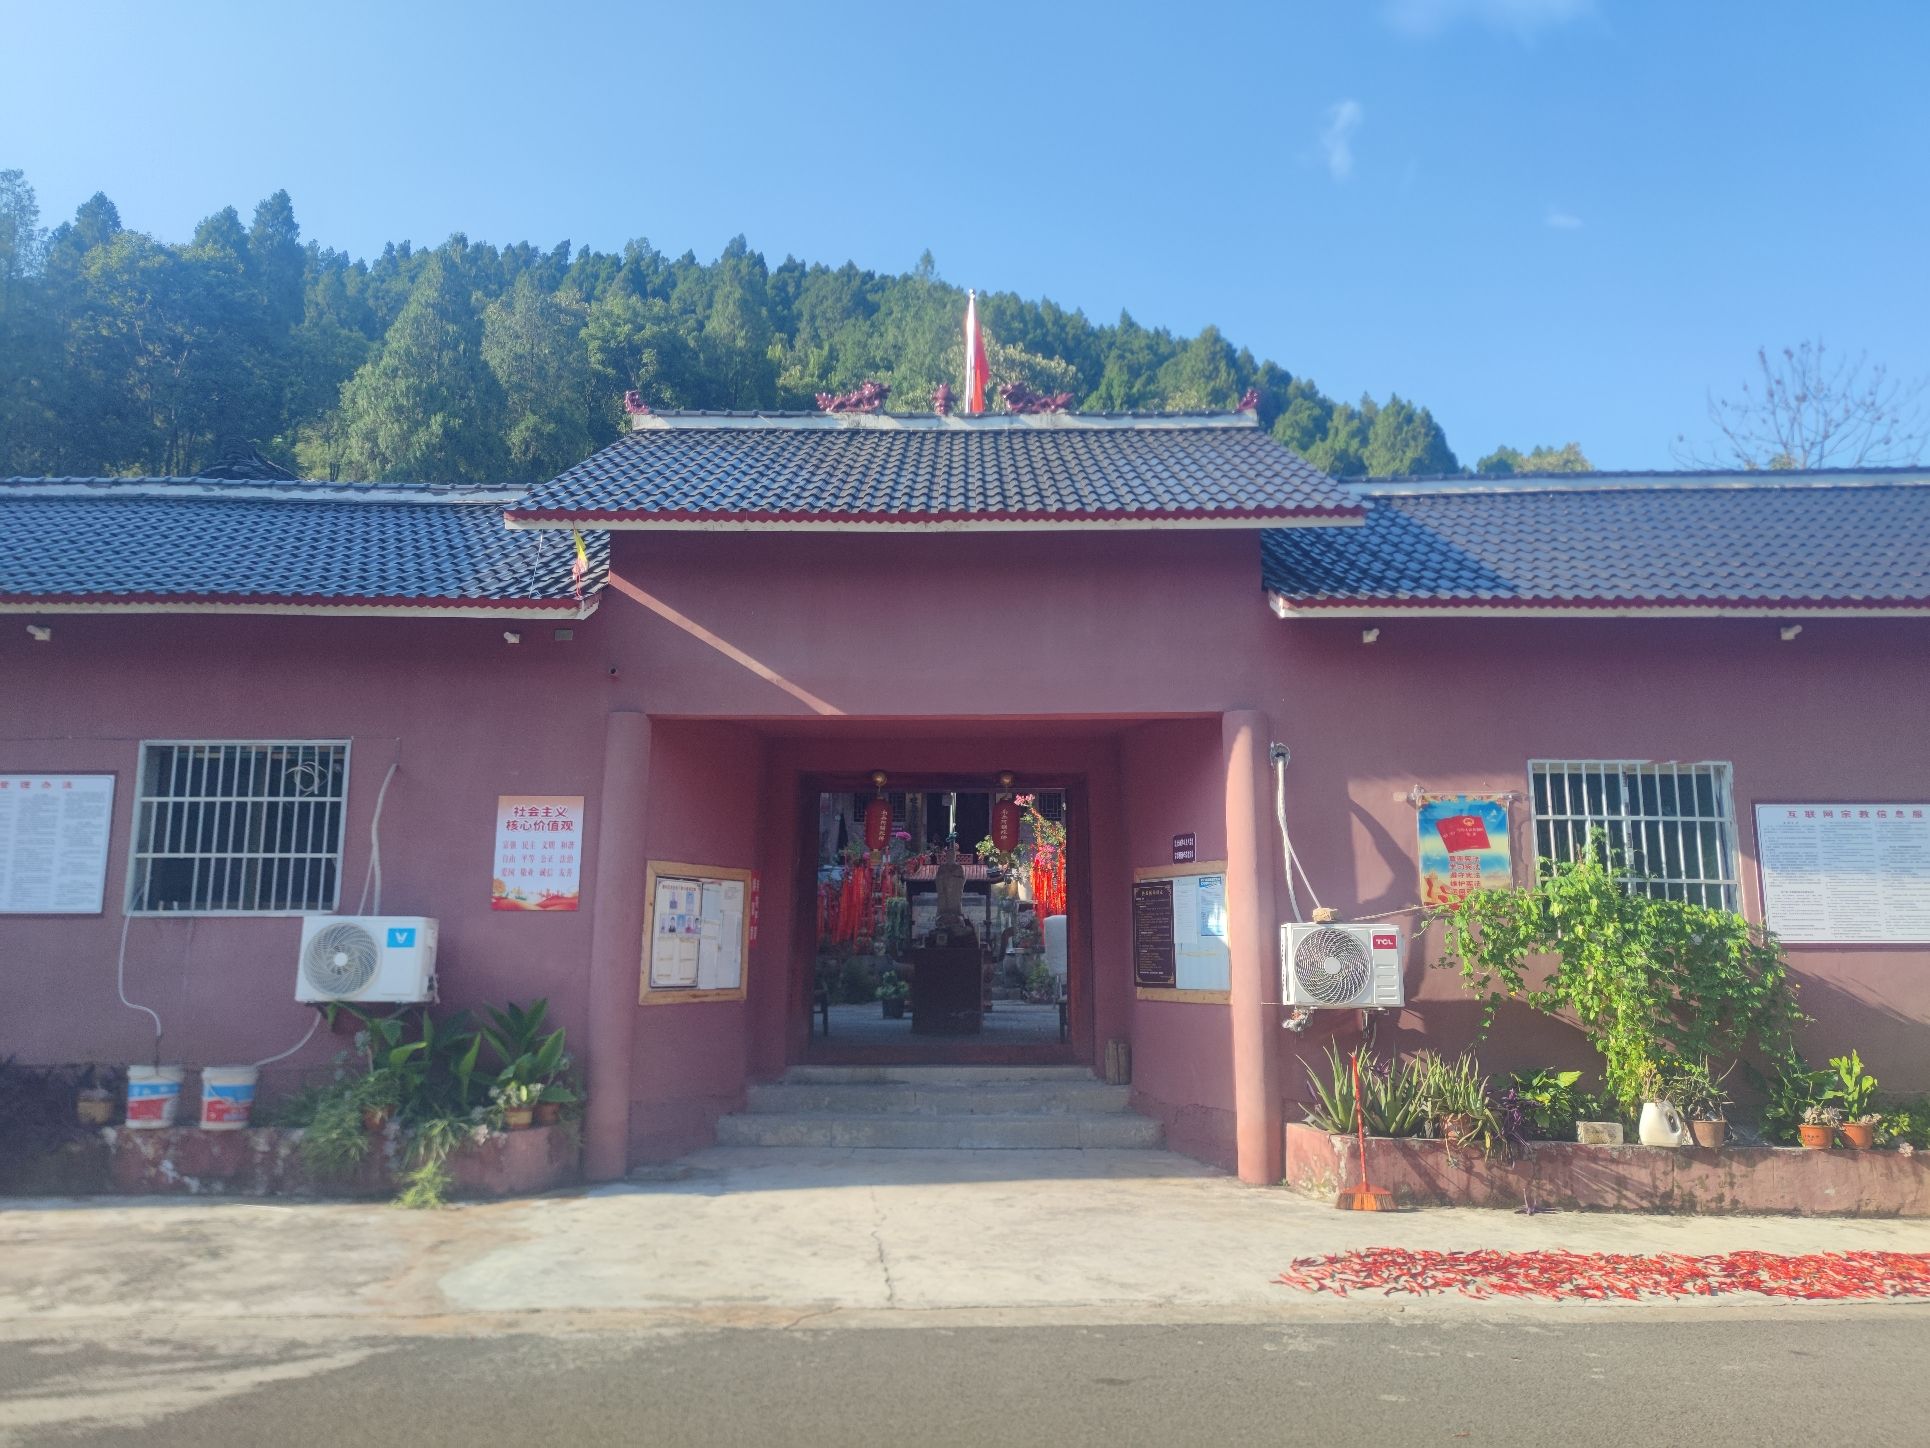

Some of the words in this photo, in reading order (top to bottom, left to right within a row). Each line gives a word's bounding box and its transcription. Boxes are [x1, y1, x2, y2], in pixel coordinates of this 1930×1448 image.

[514, 806, 568, 818] 社会主义
[1787, 809, 1923, 819] 互联网宗教信息服
[506, 819, 574, 832] 核心价值观
[522, 840, 536, 850] 民主
[542, 840, 556, 850] 文明
[561, 840, 575, 850] 和谐
[502, 854, 516, 864] 自由
[521, 854, 535, 864] 平等
[540, 854, 553, 864] 公正
